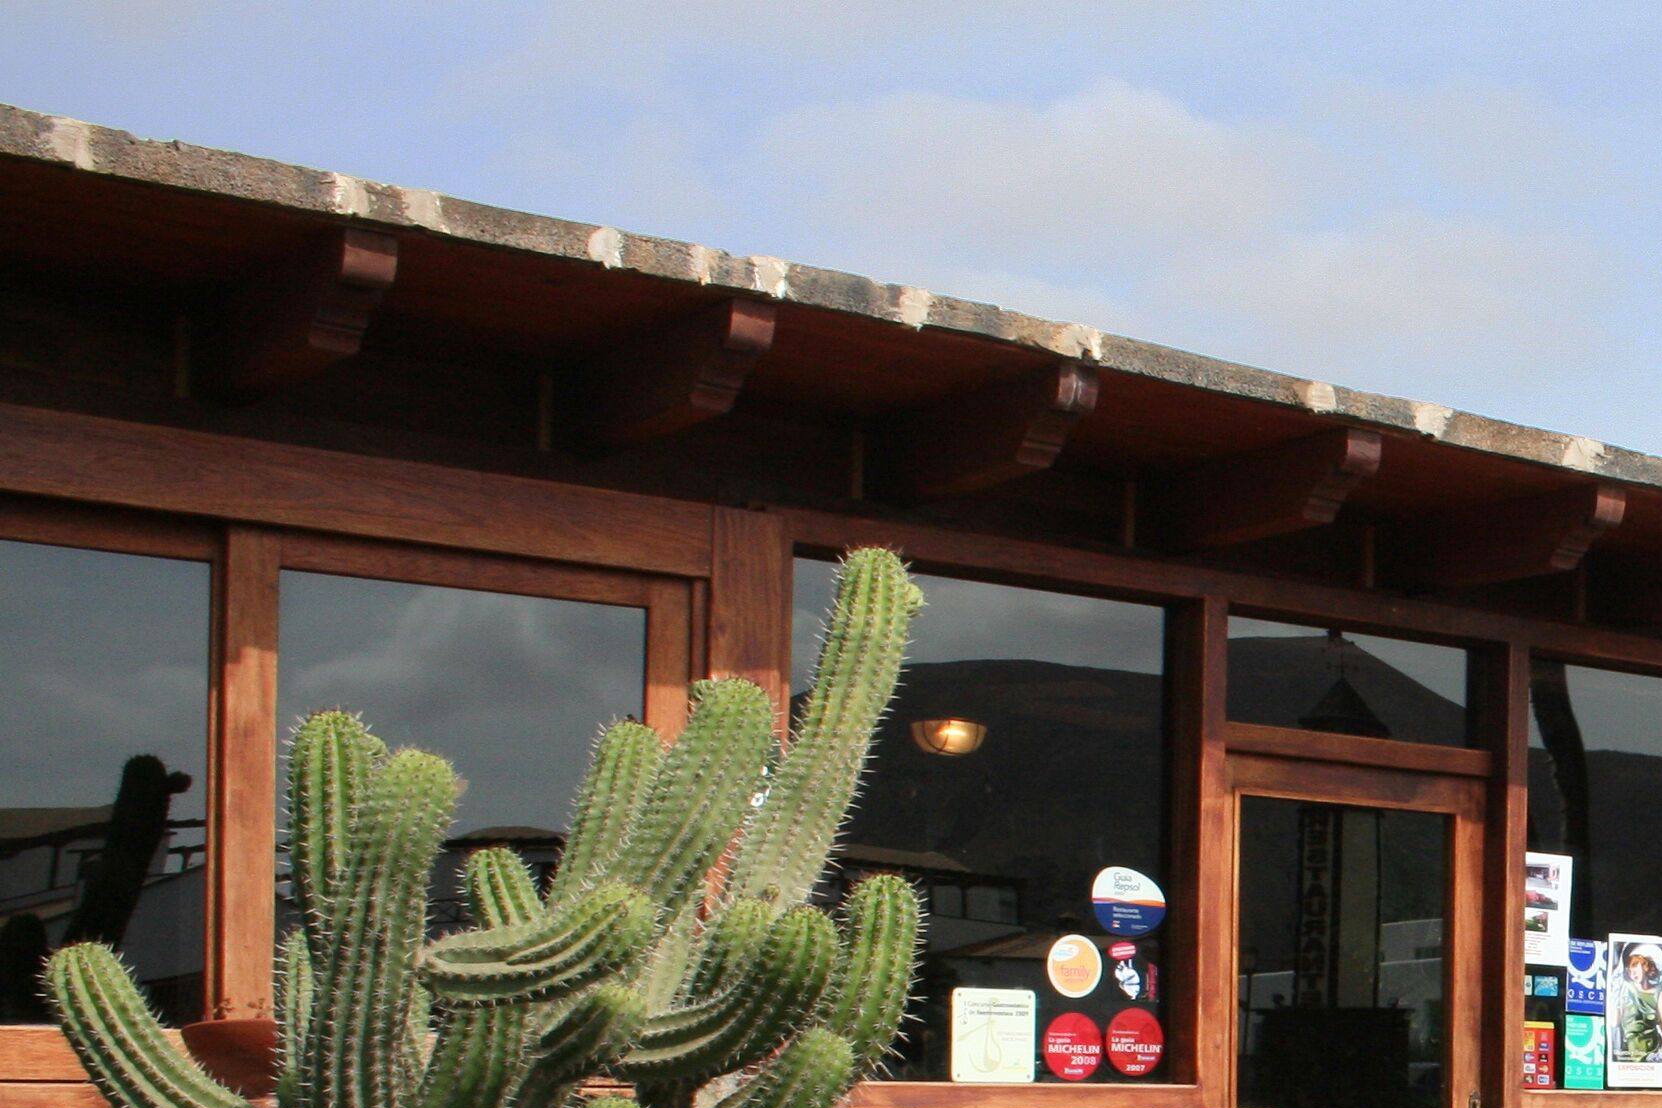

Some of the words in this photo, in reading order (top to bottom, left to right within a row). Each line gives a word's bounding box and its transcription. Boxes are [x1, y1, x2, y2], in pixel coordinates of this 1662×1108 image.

[1113, 880, 1141, 892] Repsol
[1060, 964, 1090, 978] family
[1047, 1044, 1101, 1055] MICHELIN
[1110, 1043, 1160, 1054] MICHELIN
[1125, 1064, 1146, 1072] 2007
